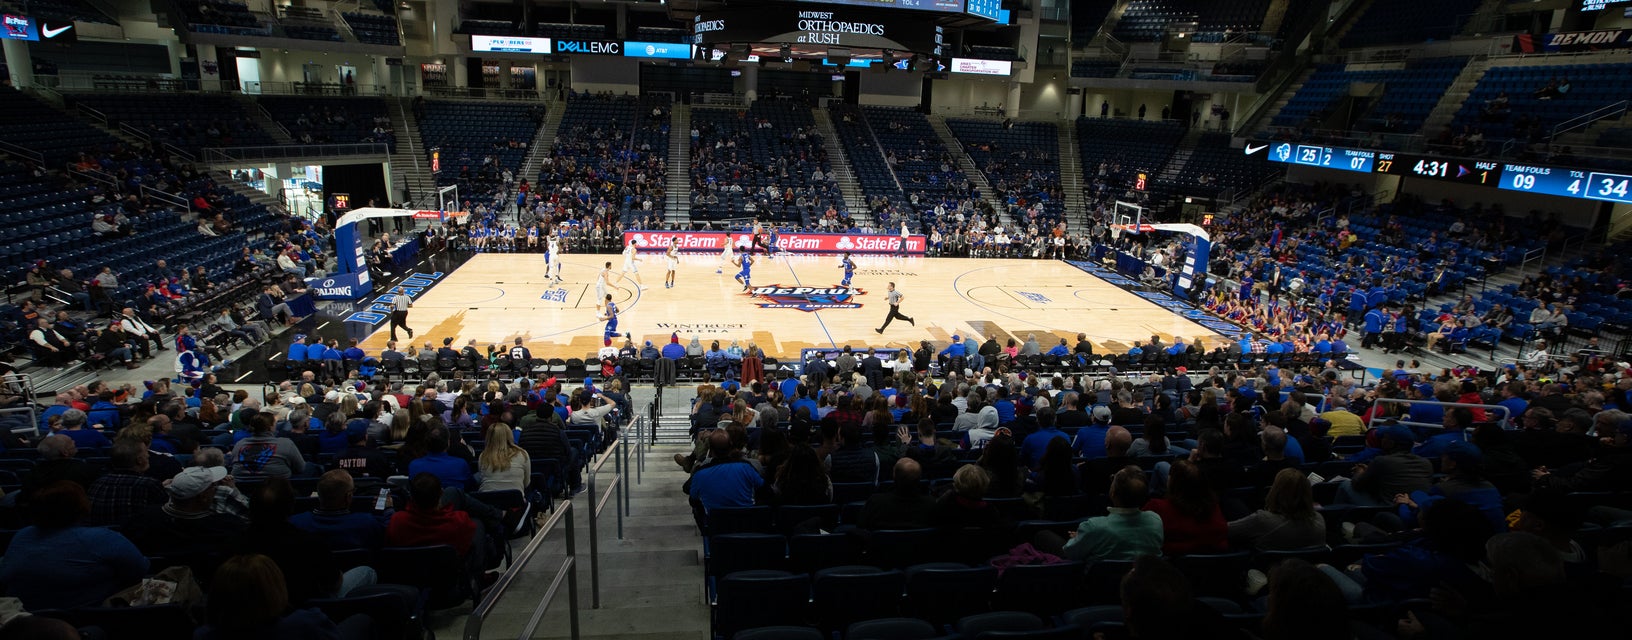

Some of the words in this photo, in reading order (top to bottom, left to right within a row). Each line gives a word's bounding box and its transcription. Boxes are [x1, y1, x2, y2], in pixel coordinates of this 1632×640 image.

[799, 11, 833, 19] MIDWEST
[798, 20, 884, 35] ORTHOPAEDICS
[808, 33, 840, 44] RUSH
[1548, 31, 1623, 46] DEMON
[558, 41, 590, 53] DELL
[591, 42, 619, 54] EMC
[1301, 149, 1317, 162] 25
[1323, 155, 1332, 165] 2
[1358, 152, 1375, 160] FOULS
[1350, 157, 1366, 170] 07
[1376, 160, 1393, 173] 27
[1413, 160, 1448, 177] 4:31
[1475, 162, 1497, 171] HALF
[1505, 165, 1524, 173] TEAM
[1525, 167, 1551, 175] FOULS
[1480, 171, 1488, 184] 1
[1513, 174, 1535, 190] 09
[1567, 180, 1580, 195] 4
[1598, 179, 1629, 198] 34
[887, 237, 917, 250] Fam
[314, 286, 352, 297] PALDING
[339, 458, 367, 468] PAYTON
